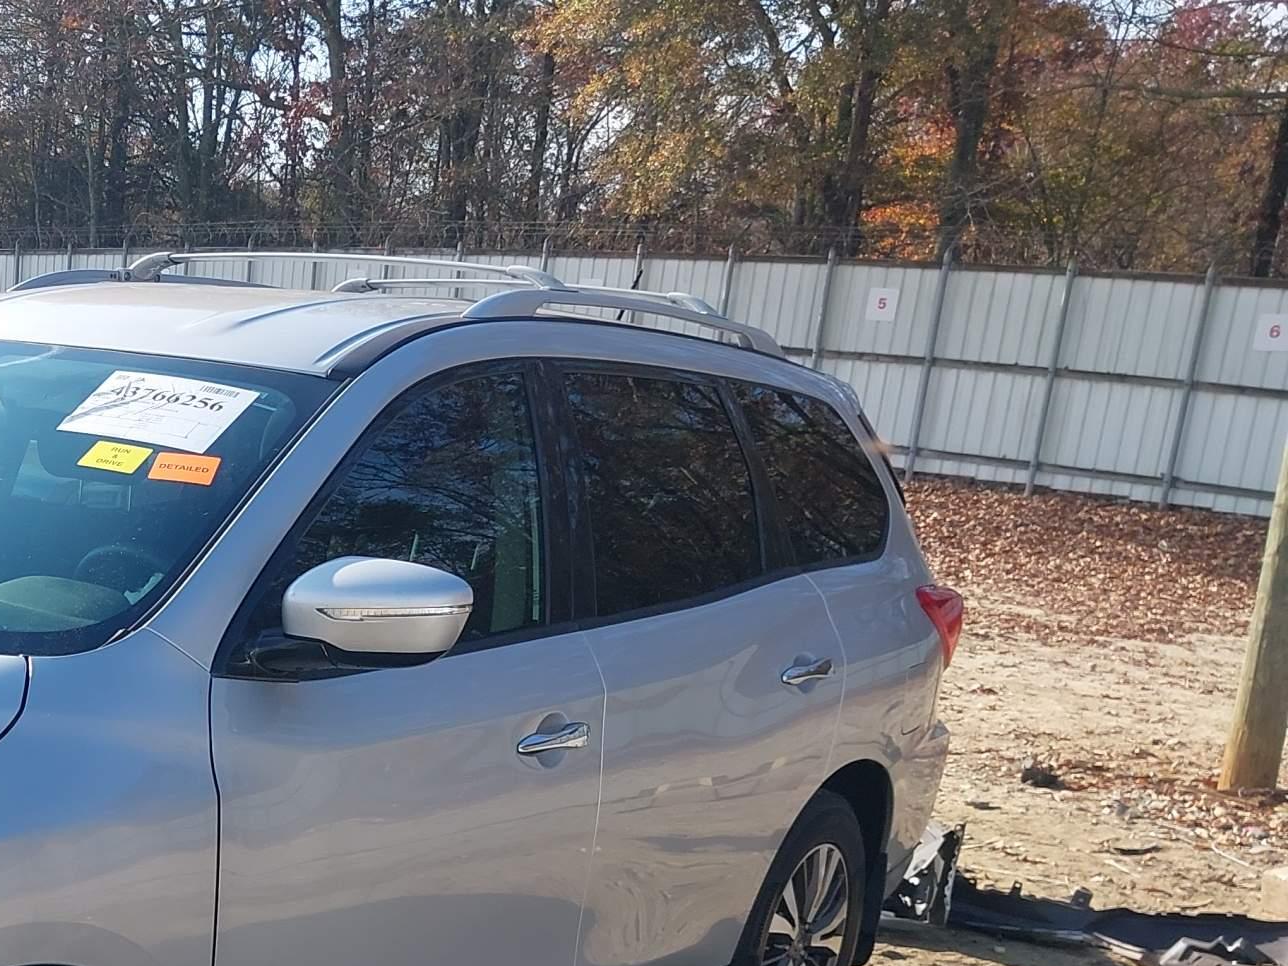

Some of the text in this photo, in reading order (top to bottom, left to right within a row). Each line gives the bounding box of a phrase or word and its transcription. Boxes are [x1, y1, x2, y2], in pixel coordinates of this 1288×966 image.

[877, 297, 888, 310] 5
[1269, 324, 1281, 338] 6
[111, 384, 224, 412] 43766256
[111, 446, 132, 454] RUN
[96, 459, 125, 467] DRIVE
[159, 463, 210, 474] DETAILED
